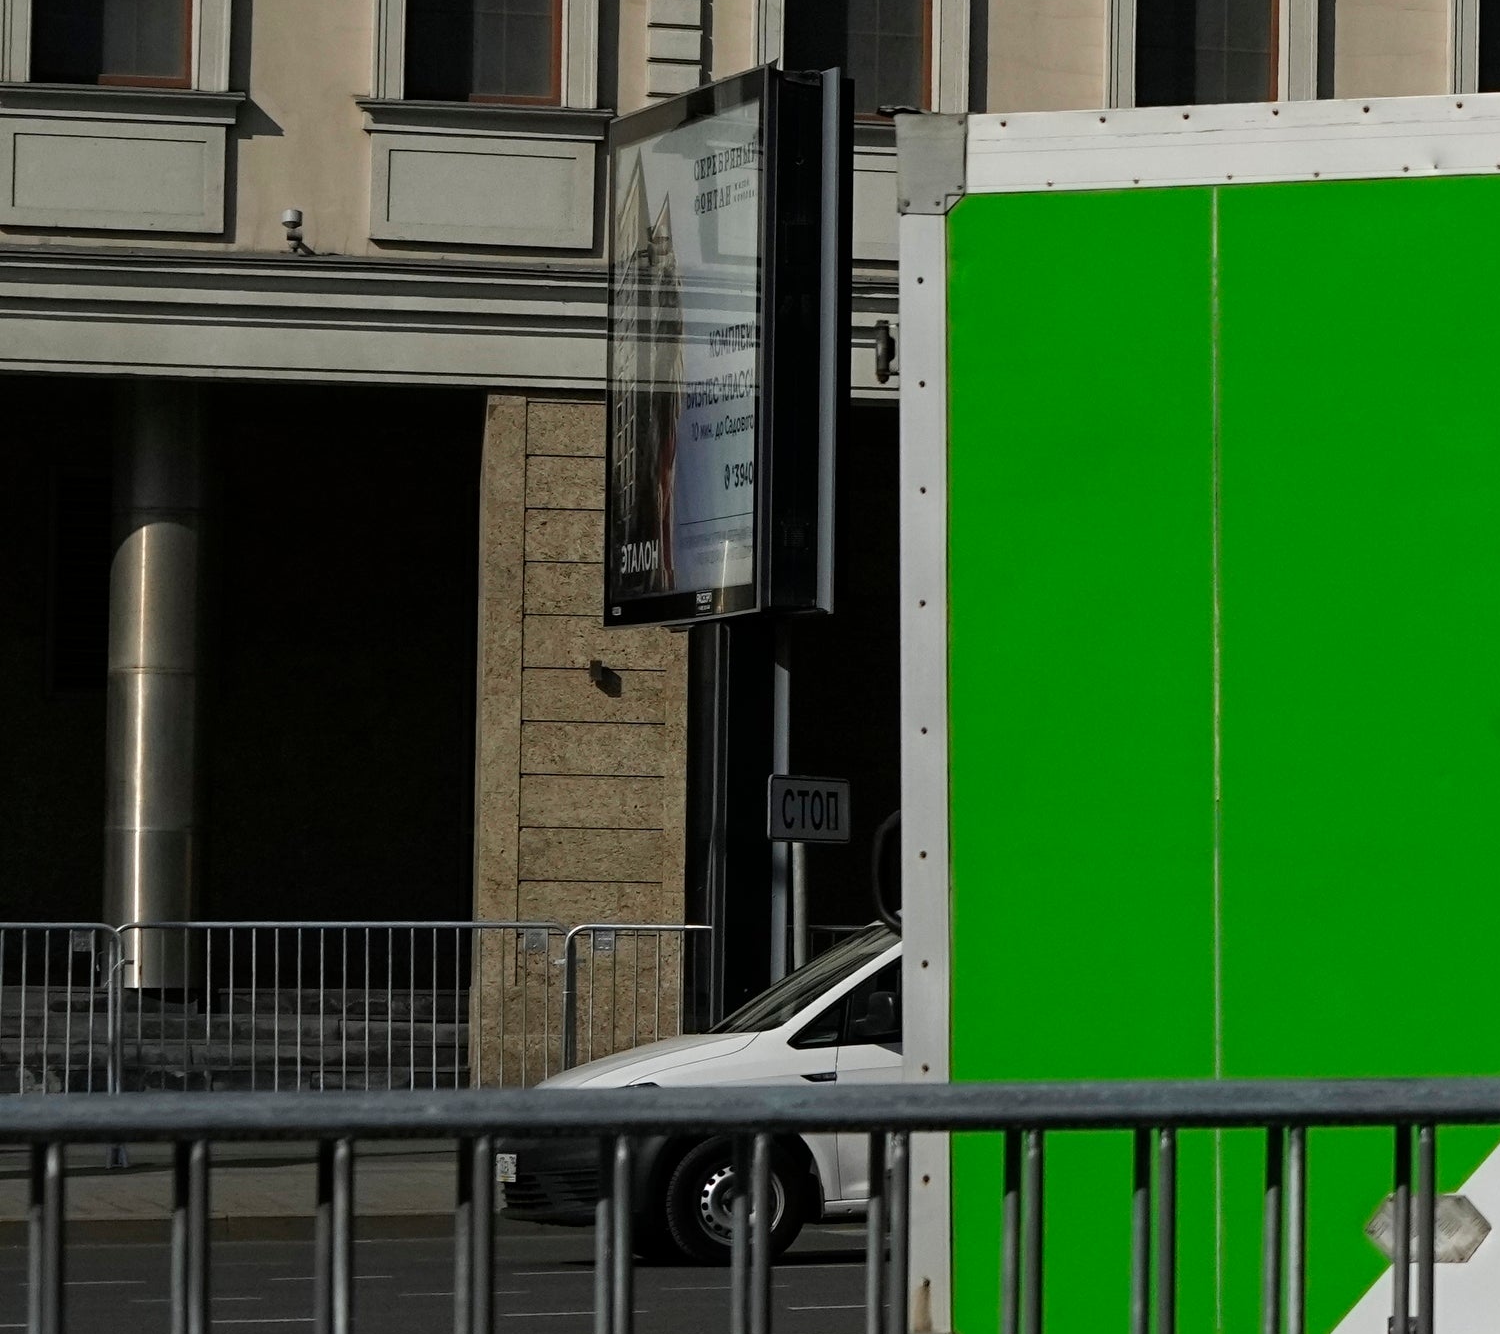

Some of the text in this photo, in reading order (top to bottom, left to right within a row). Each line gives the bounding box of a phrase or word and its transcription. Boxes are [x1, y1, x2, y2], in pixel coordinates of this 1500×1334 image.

[694, 185, 732, 216] ФОНТАН
[715, 421, 724, 441] до
[621, 539, 659, 574] ЭТАЛОН
[782, 788, 839, 831] СТОП
